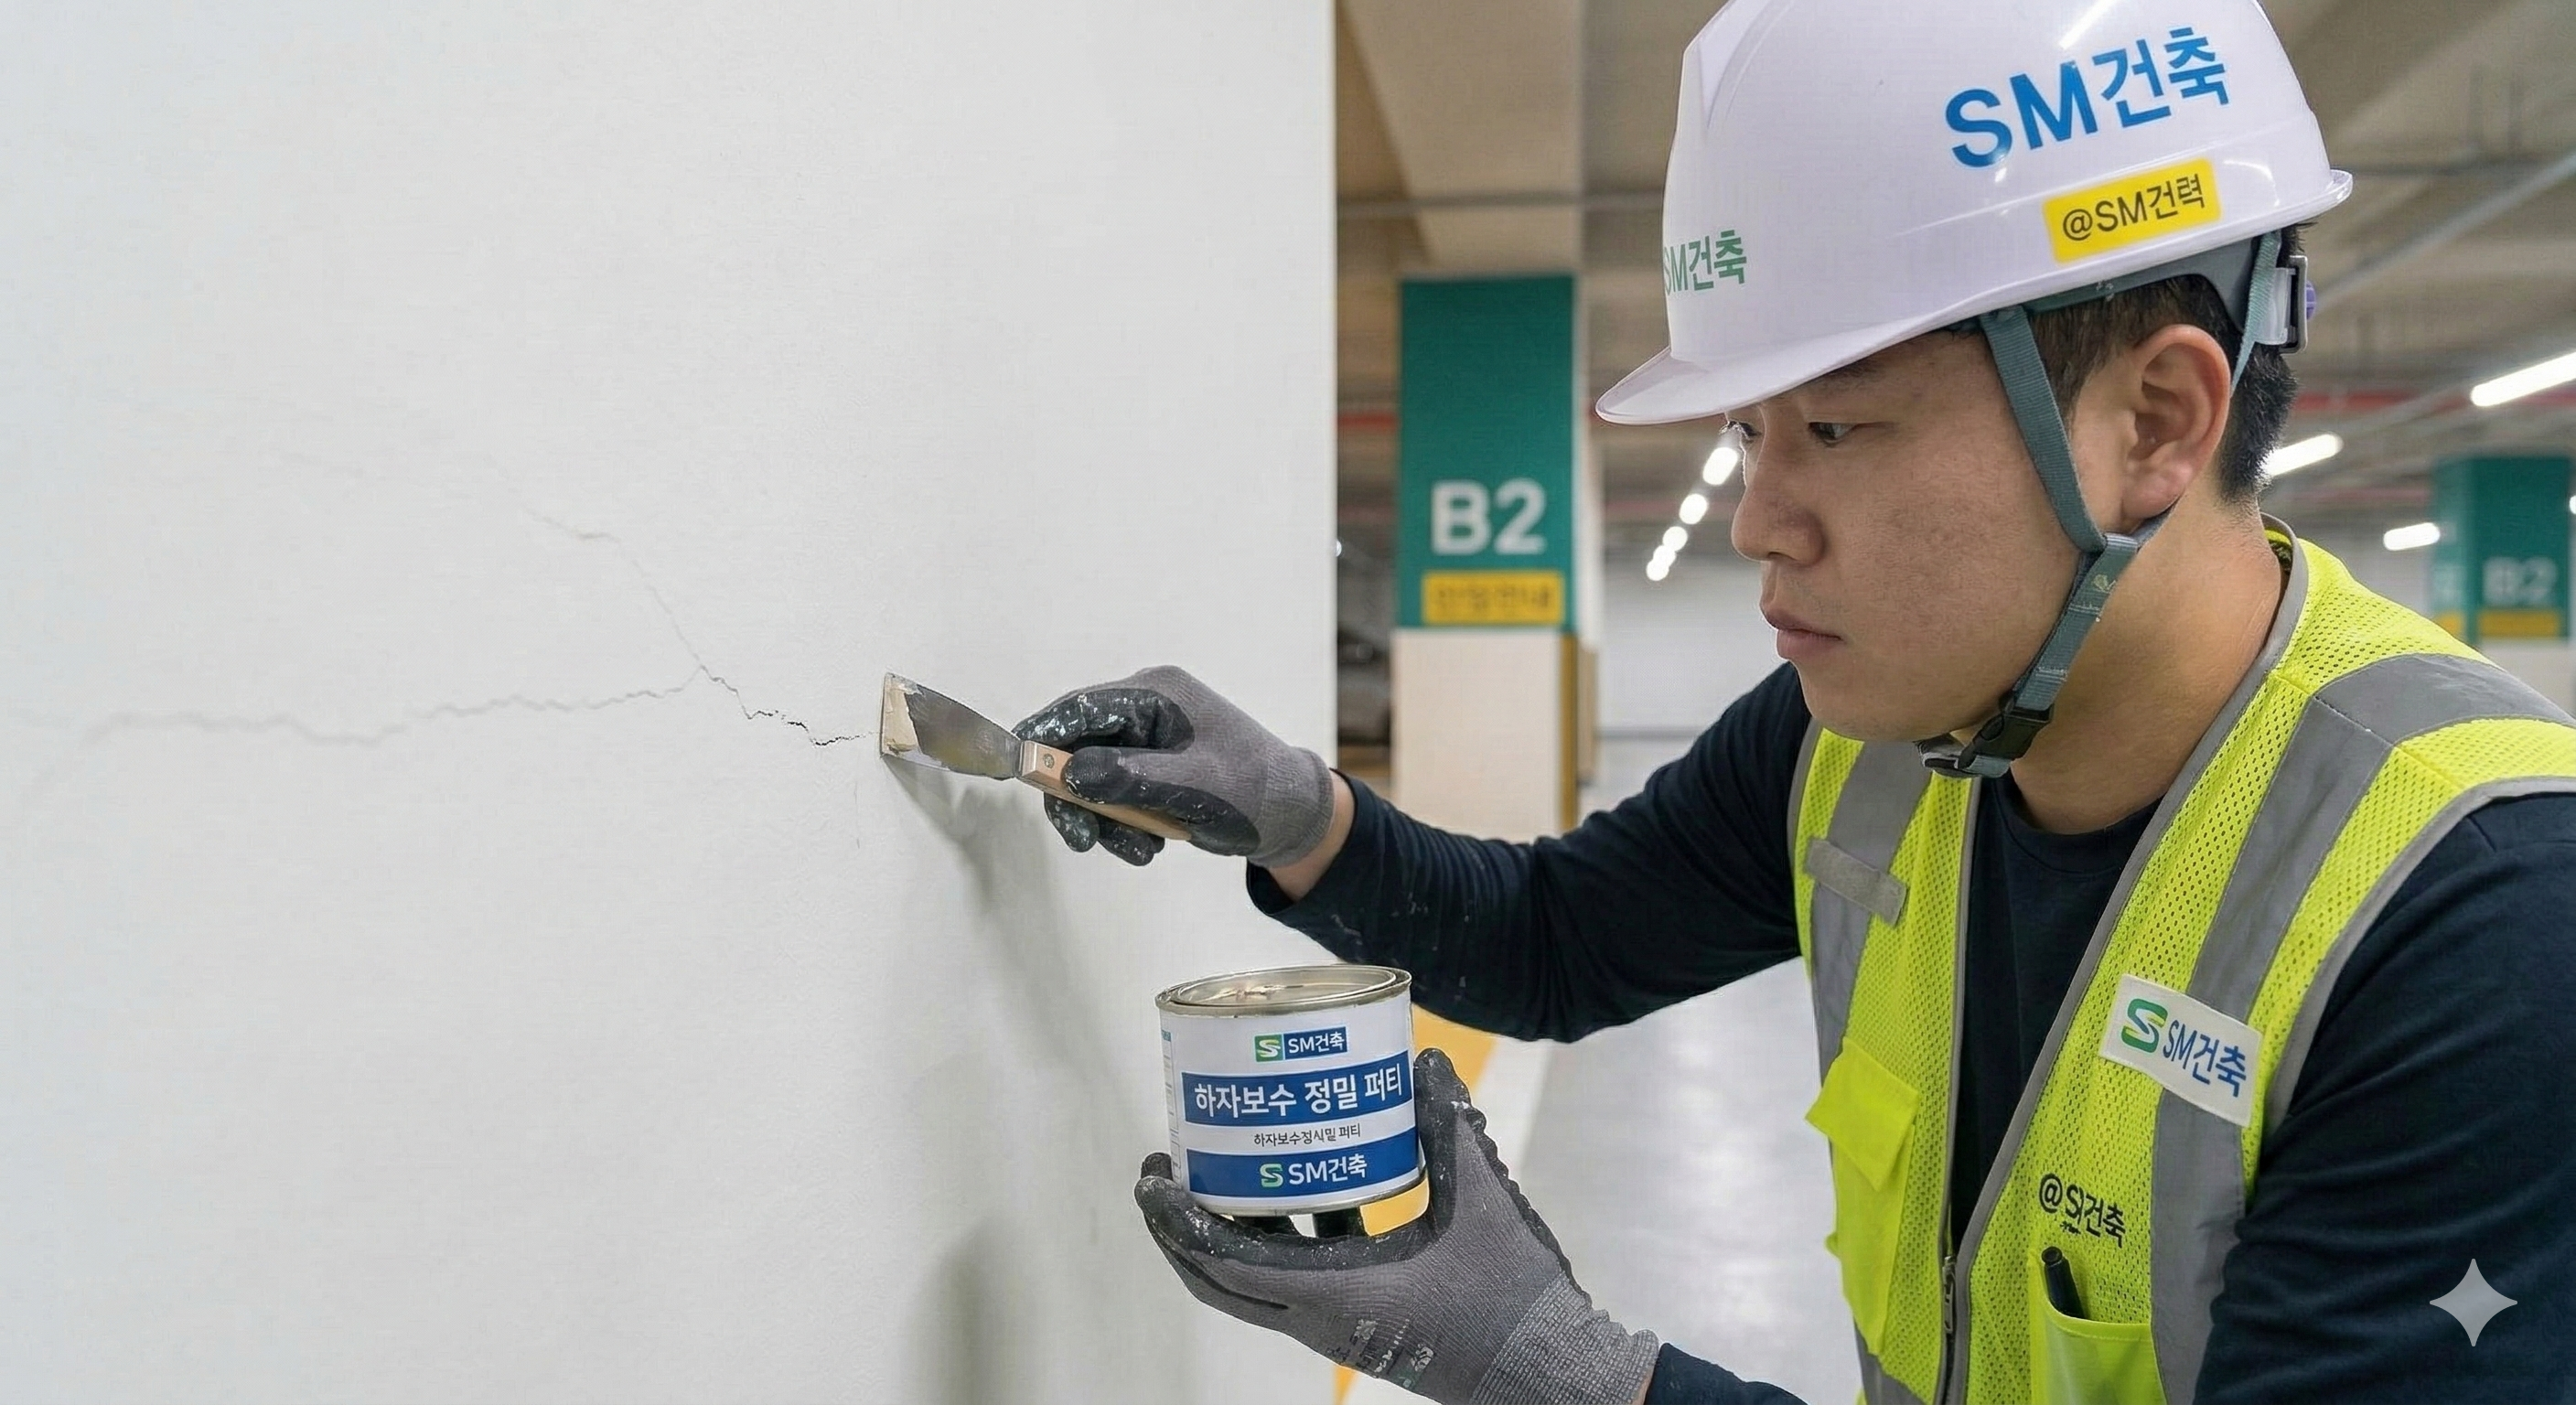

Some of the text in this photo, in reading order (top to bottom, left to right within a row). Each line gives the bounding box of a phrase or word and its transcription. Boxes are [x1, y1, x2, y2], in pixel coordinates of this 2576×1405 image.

[1945, 27, 2229, 167] SM건축
[2062, 173, 2206, 241] @SM건력
[1431, 477, 1548, 555] B2
[1288, 1031, 1345, 1054] SM건축
[2163, 1019, 2246, 1098] SM건축
[1195, 1063, 1402, 1118] 하자보수 정밀 퍼티
[1338, 1123, 1361, 1139] 퍼티
[1288, 1153, 1368, 1185] SM건축
